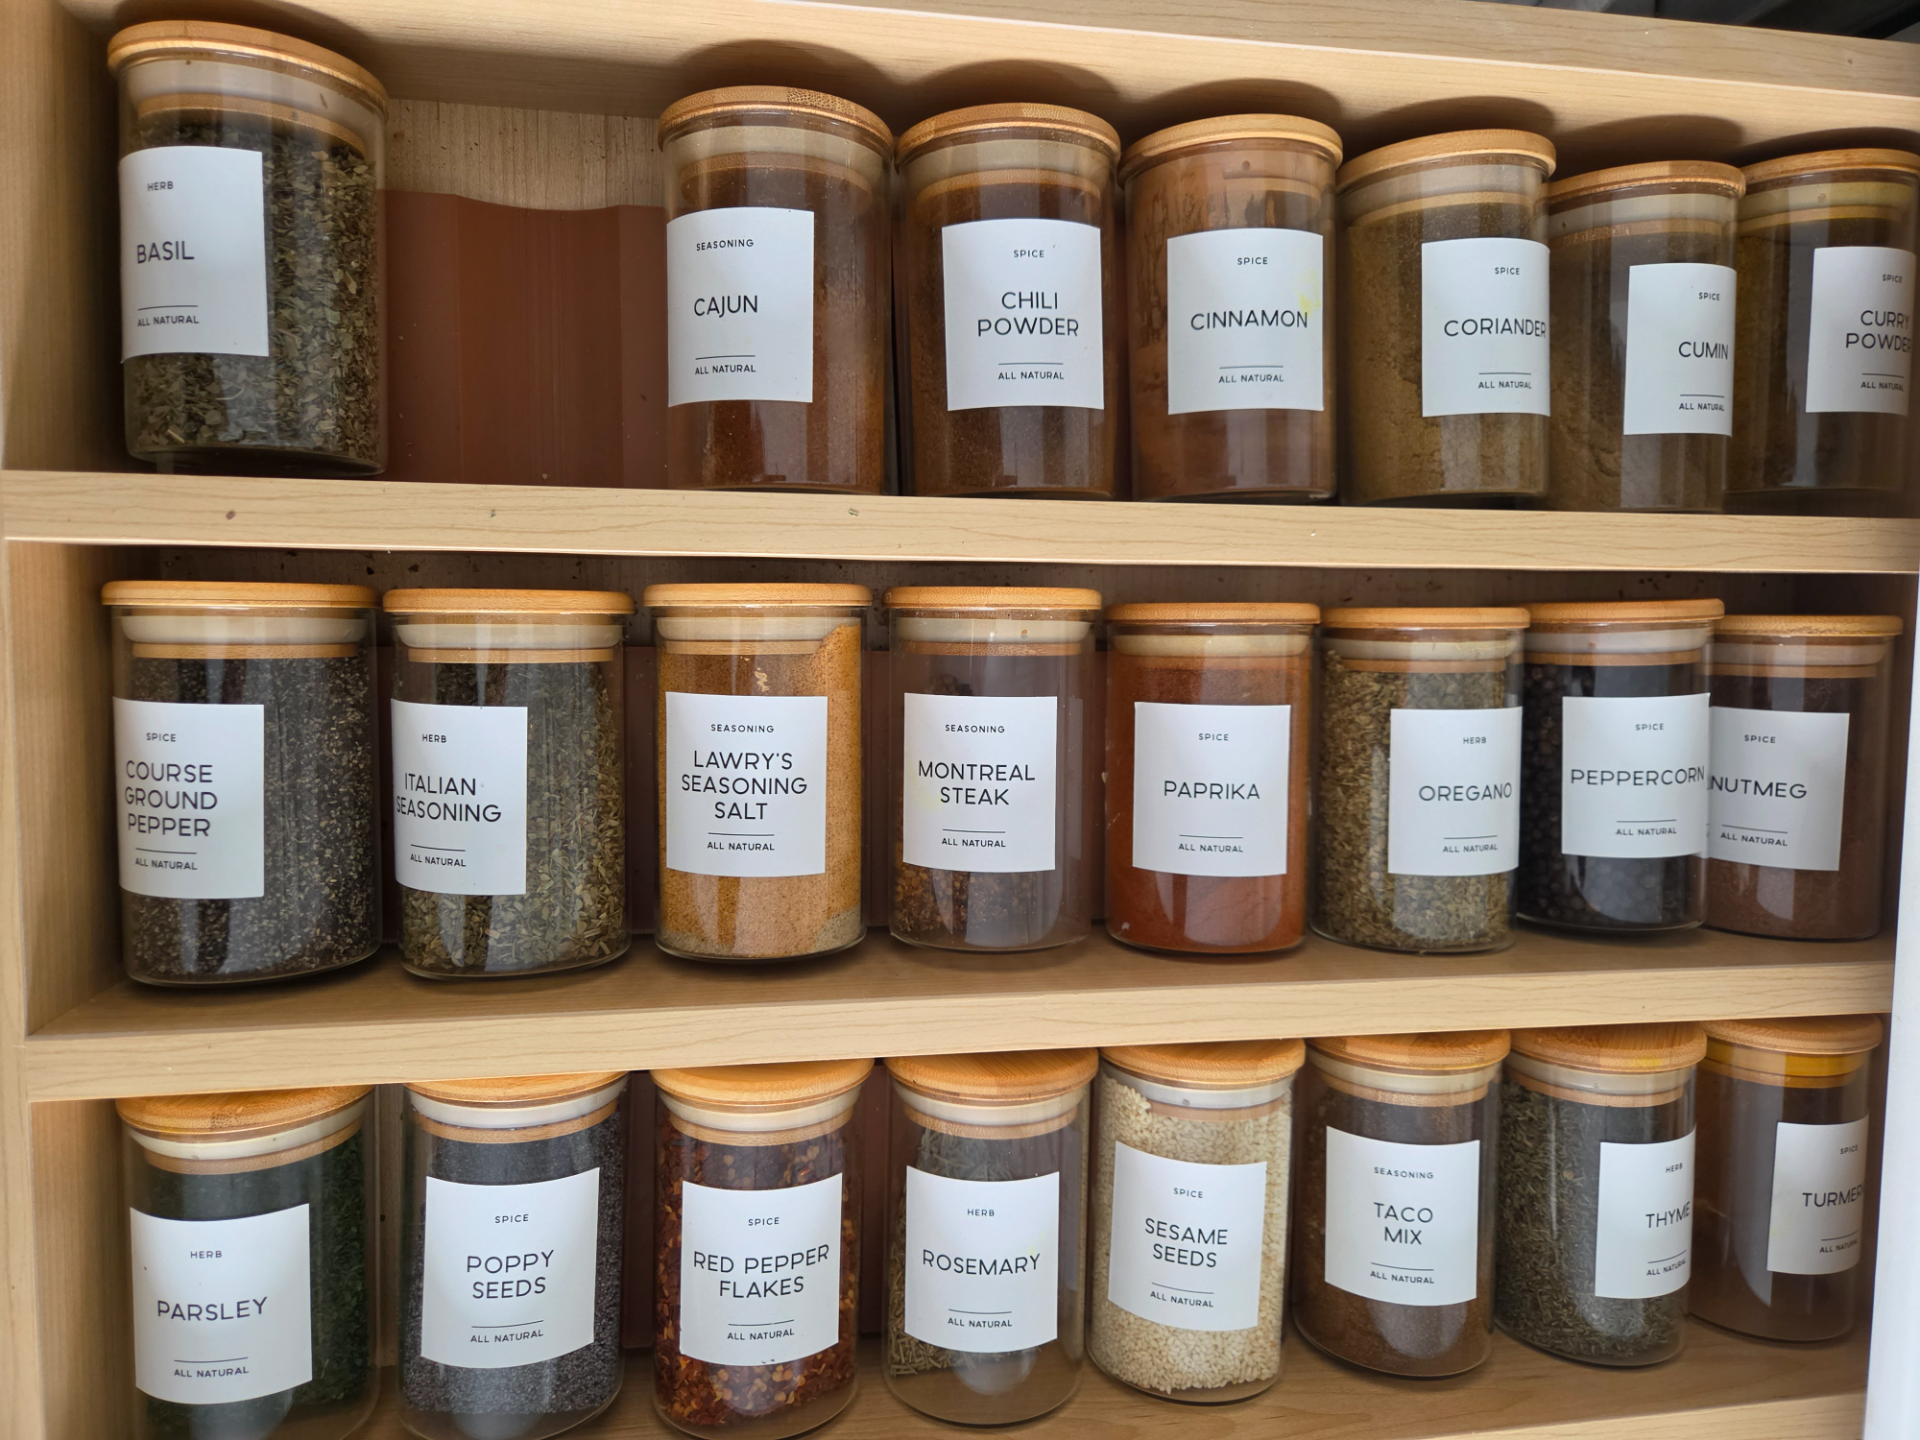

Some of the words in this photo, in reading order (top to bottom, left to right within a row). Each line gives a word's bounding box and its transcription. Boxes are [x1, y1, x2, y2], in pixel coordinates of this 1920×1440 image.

[148, 181, 173, 191] HERB
[697, 239, 754, 251] SEASONING
[137, 241, 194, 264] BASIL
[1014, 250, 1044, 258] SPICE
[1237, 257, 1267, 265] SPICE
[1495, 267, 1519, 275] SPICE
[1883, 274, 1902, 283] SPICE
[1002, 291, 1057, 309] CHILI
[1699, 292, 1720, 301] SPICE
[694, 295, 757, 318] CAJUN
[138, 317, 151, 327] ALL
[155, 314, 199, 325] NATURAL
[1191, 310, 1307, 330] CINNAMON
[1860, 310, 1910, 329] CURRY
[978, 317, 1078, 337] POWDER
[1444, 318, 1545, 337] CORIANDER
[1679, 341, 1729, 361] CUMIN
[695, 367, 709, 375] ALL
[713, 365, 756, 373] NATURAL
[998, 372, 1016, 380] ALL
[1021, 371, 1064, 379] NATURAL
[1218, 375, 1236, 383] ALL
[1241, 374, 1284, 382] NATURAL
[1478, 381, 1495, 389] ALL
[1499, 381, 1531, 389] NATURAL
[1698, 403, 1724, 411] NATURAL
[711, 724, 774, 733] SEASONING
[945, 724, 1005, 733] SEASONING
[1636, 723, 1663, 731] SPICE
[146, 733, 176, 742] SPICE
[422, 734, 446, 743] HERB
[1199, 733, 1228, 741] SPICE
[1744, 735, 1776, 743] SPICE
[694, 750, 792, 770] LAWRY'S
[127, 760, 212, 783] COURSE
[919, 760, 1035, 781] MONTREAL
[1571, 765, 1705, 787] PEPPERCORN
[405, 773, 475, 795] ITALIAN
[682, 774, 807, 795] SEASONING
[1164, 780, 1260, 799] PAPRIKA
[1710, 776, 1807, 799] NUTMEG
[126, 787, 217, 810] GROUND
[941, 787, 1009, 805] STEAK
[1419, 783, 1512, 801] OREGANO
[397, 797, 501, 822] SEASONING
[715, 802, 767, 819] SALT
[129, 813, 210, 836] PEPPER
[942, 838, 958, 846] ALL
[962, 839, 1006, 847] NATURAL
[1721, 832, 1737, 840] ALL
[1741, 835, 1787, 846] NATURAL
[707, 842, 724, 850] ALL
[729, 843, 775, 851] NATURAL
[1178, 843, 1195, 851] ALL
[1463, 844, 1497, 852] NATURAL
[135, 858, 148, 867] ALL
[152, 860, 197, 870] NATURAL
[410, 854, 422, 863] ALL
[426, 856, 466, 867] NATURAL
[1840, 1144, 1858, 1154] SPICE
[1374, 1167, 1433, 1179] SEASONING
[1666, 1163, 1683, 1173] HERB
[1174, 1188, 1203, 1198] SPICE
[1802, 1184, 1862, 1207] TURMER
[495, 1214, 528, 1223] SPICE
[1374, 1202, 1433, 1223] TACO
[1645, 1201, 1690, 1228] THYME
[748, 1217, 779, 1226] SPICE
[1145, 1218, 1229, 1245] SESAME
[1385, 1227, 1421, 1245] MIX
[191, 1251, 222, 1259] HERB
[694, 1251, 734, 1273] RED
[745, 1244, 830, 1274] PEPPER
[1153, 1243, 1218, 1268] SEEDS
[467, 1250, 554, 1274] POPPY
[923, 1249, 1040, 1275] ROSEMARY
[1663, 1258, 1686, 1273] NATURAL
[1370, 1271, 1387, 1280] ALL
[1391, 1274, 1434, 1284] NATURAL
[473, 1277, 545, 1299] SEEDS
[720, 1276, 804, 1298] FLAKES
[1150, 1291, 1167, 1301] ALL
[1171, 1296, 1213, 1307] NATURAL
[158, 1297, 267, 1321] PARSLEY
[948, 1318, 965, 1326] ALL
[969, 1318, 1012, 1328] NATURAL
[470, 1335, 490, 1343] ALL
[494, 1330, 543, 1342] NATURAL
[727, 1332, 745, 1340] ALL
[750, 1328, 794, 1340] NATURAL
[174, 1369, 192, 1377] ALL
[197, 1366, 249, 1377] NATURAL
